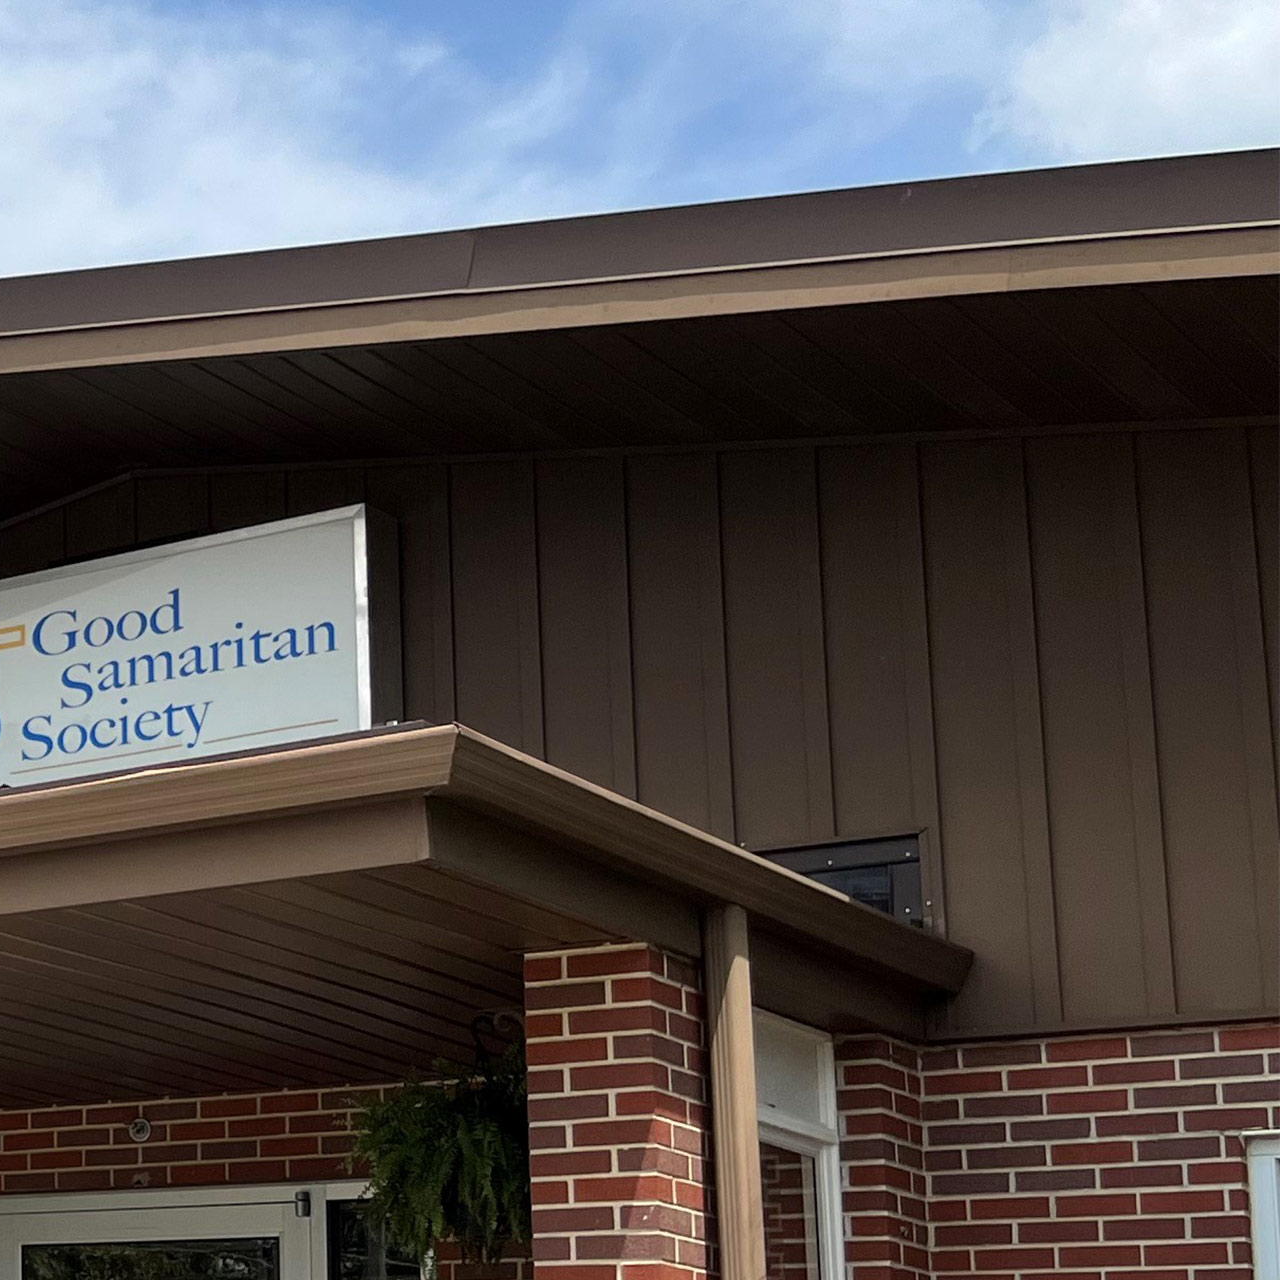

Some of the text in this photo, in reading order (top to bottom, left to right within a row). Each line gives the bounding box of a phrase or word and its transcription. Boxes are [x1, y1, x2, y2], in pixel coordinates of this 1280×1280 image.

[32, 588, 184, 657] Good
[60, 620, 339, 709] Samaritan
[20, 697, 213, 761] Society
